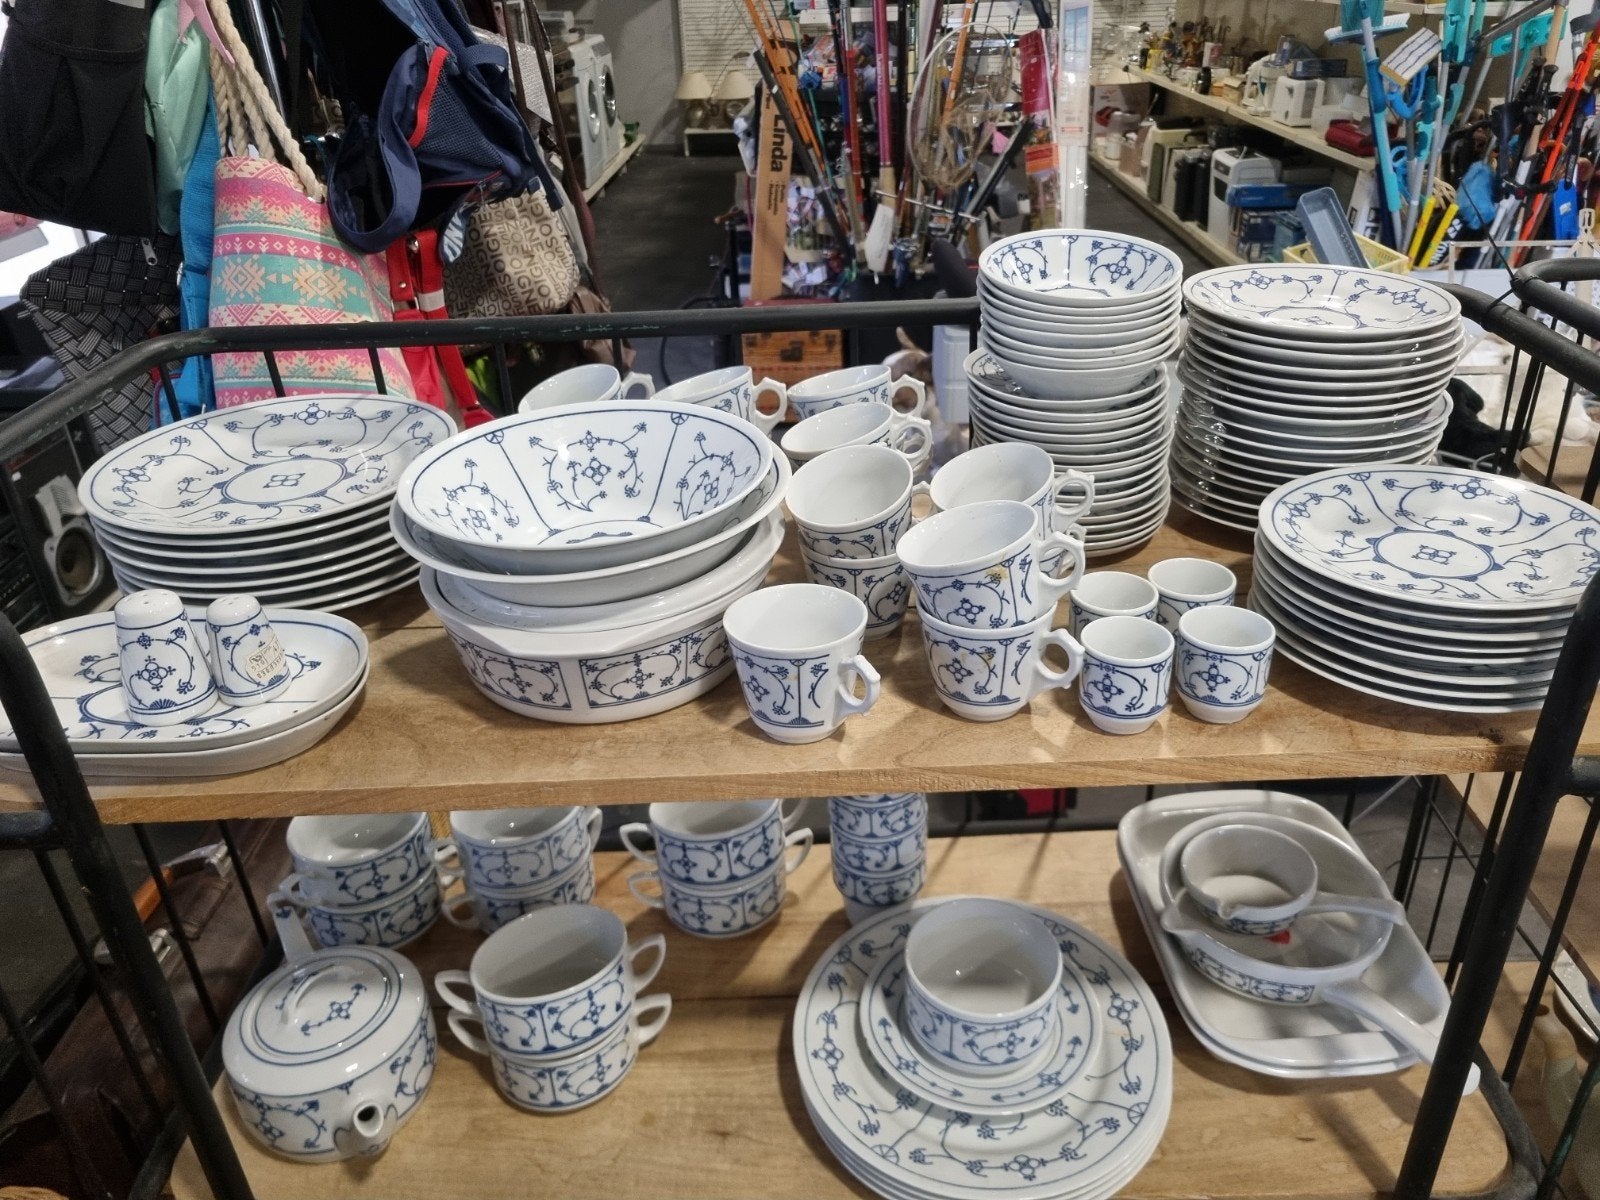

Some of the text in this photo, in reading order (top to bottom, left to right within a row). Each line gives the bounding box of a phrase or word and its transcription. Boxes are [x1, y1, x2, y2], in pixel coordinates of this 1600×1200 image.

[771, 114, 788, 172] Linda
[478, 212, 511, 285] SOIGNE
[506, 244, 542, 315] SOIGNE
[521, 243, 556, 309] SOIGNE
